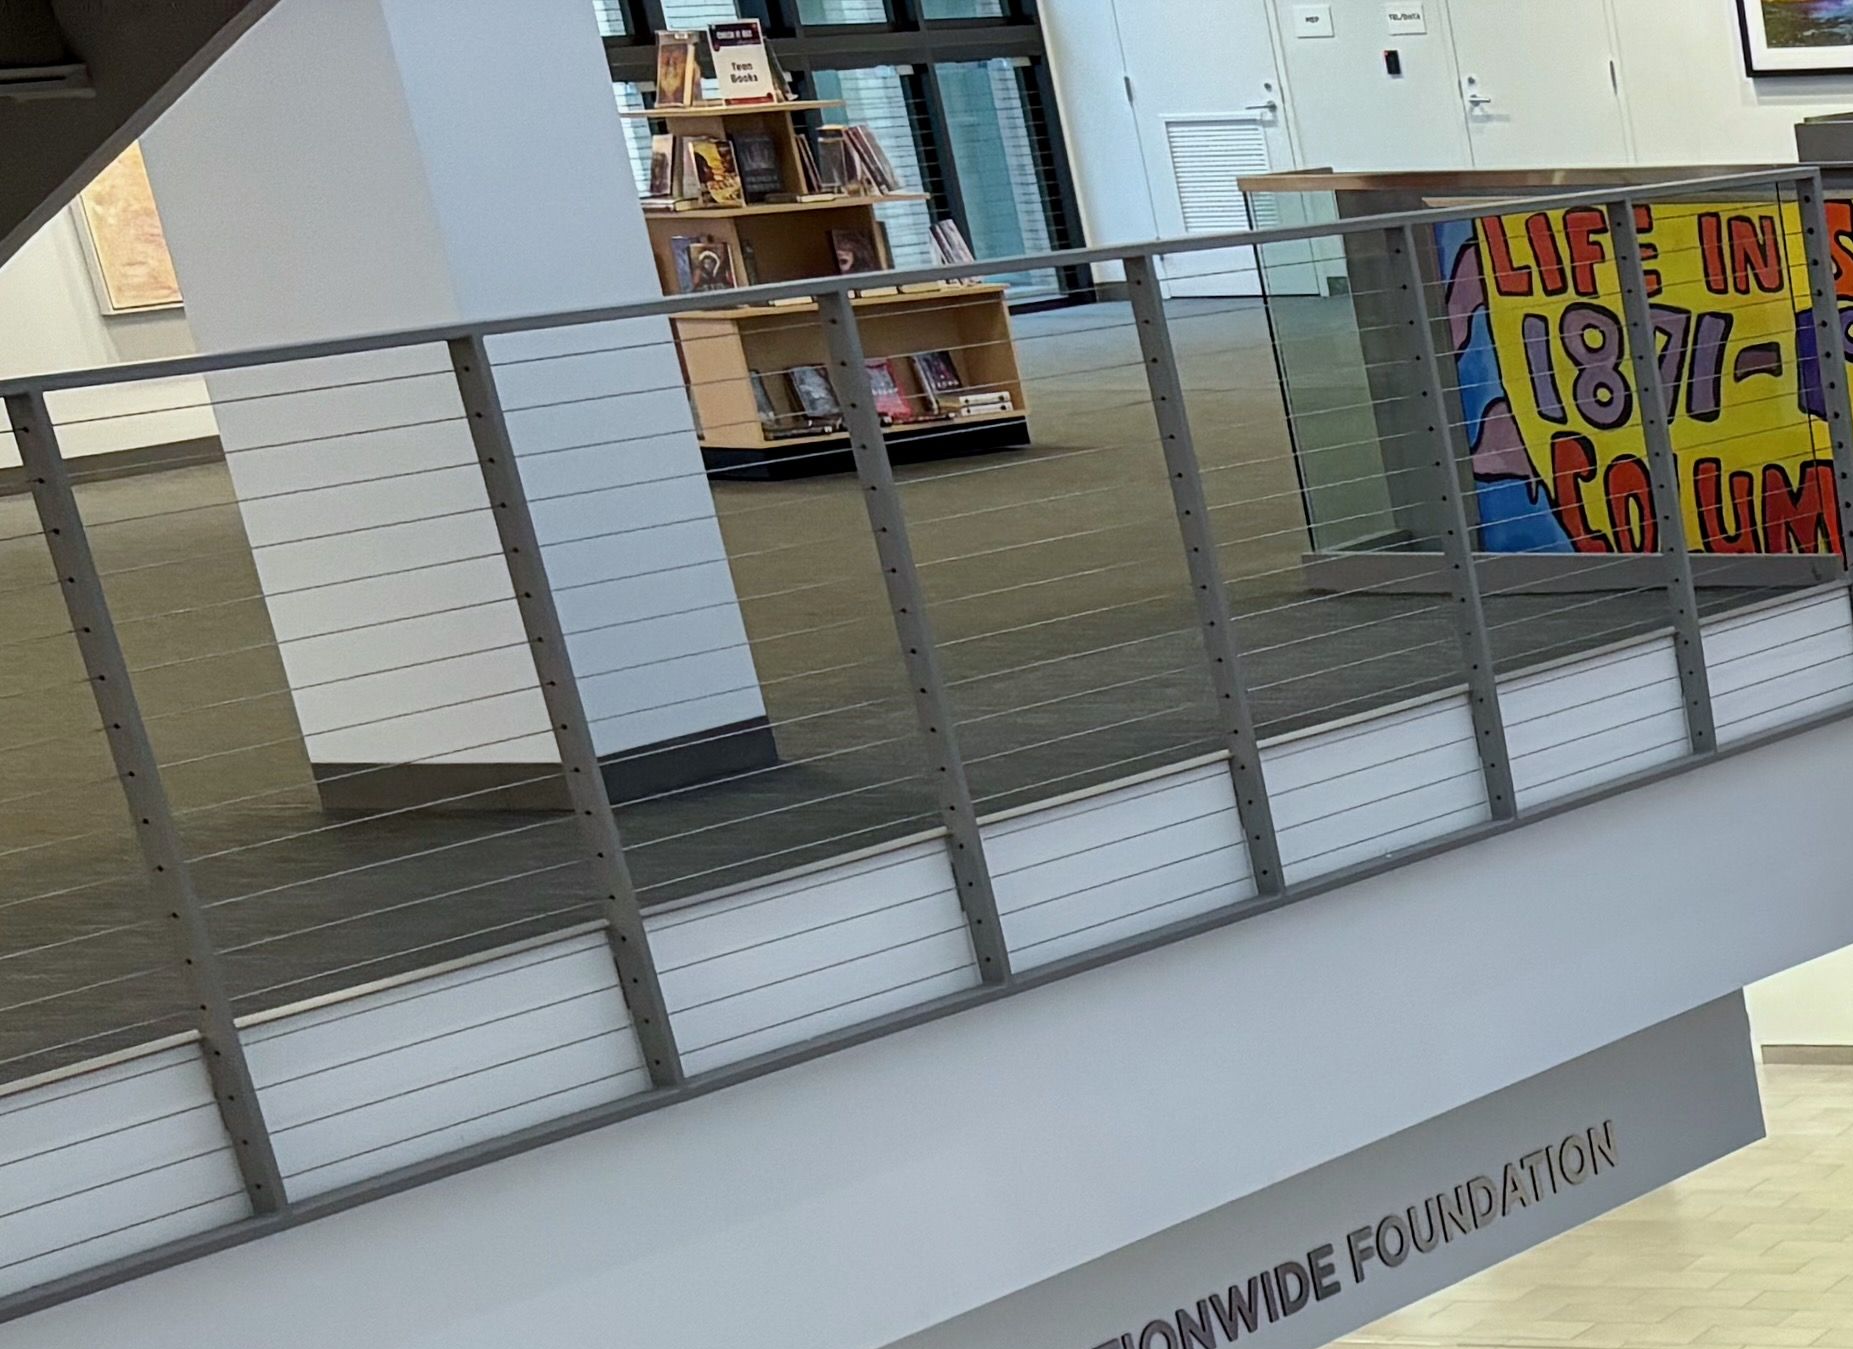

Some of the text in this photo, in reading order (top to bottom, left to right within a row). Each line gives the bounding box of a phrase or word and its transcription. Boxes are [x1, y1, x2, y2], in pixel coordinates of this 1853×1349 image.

[730, 73, 758, 84] Books
[731, 62, 753, 71] Teen
[1482, 205, 1662, 298] LIFE
[1697, 211, 1784, 295] IN
[1344, 1118, 1619, 1284] FOUNDATION
